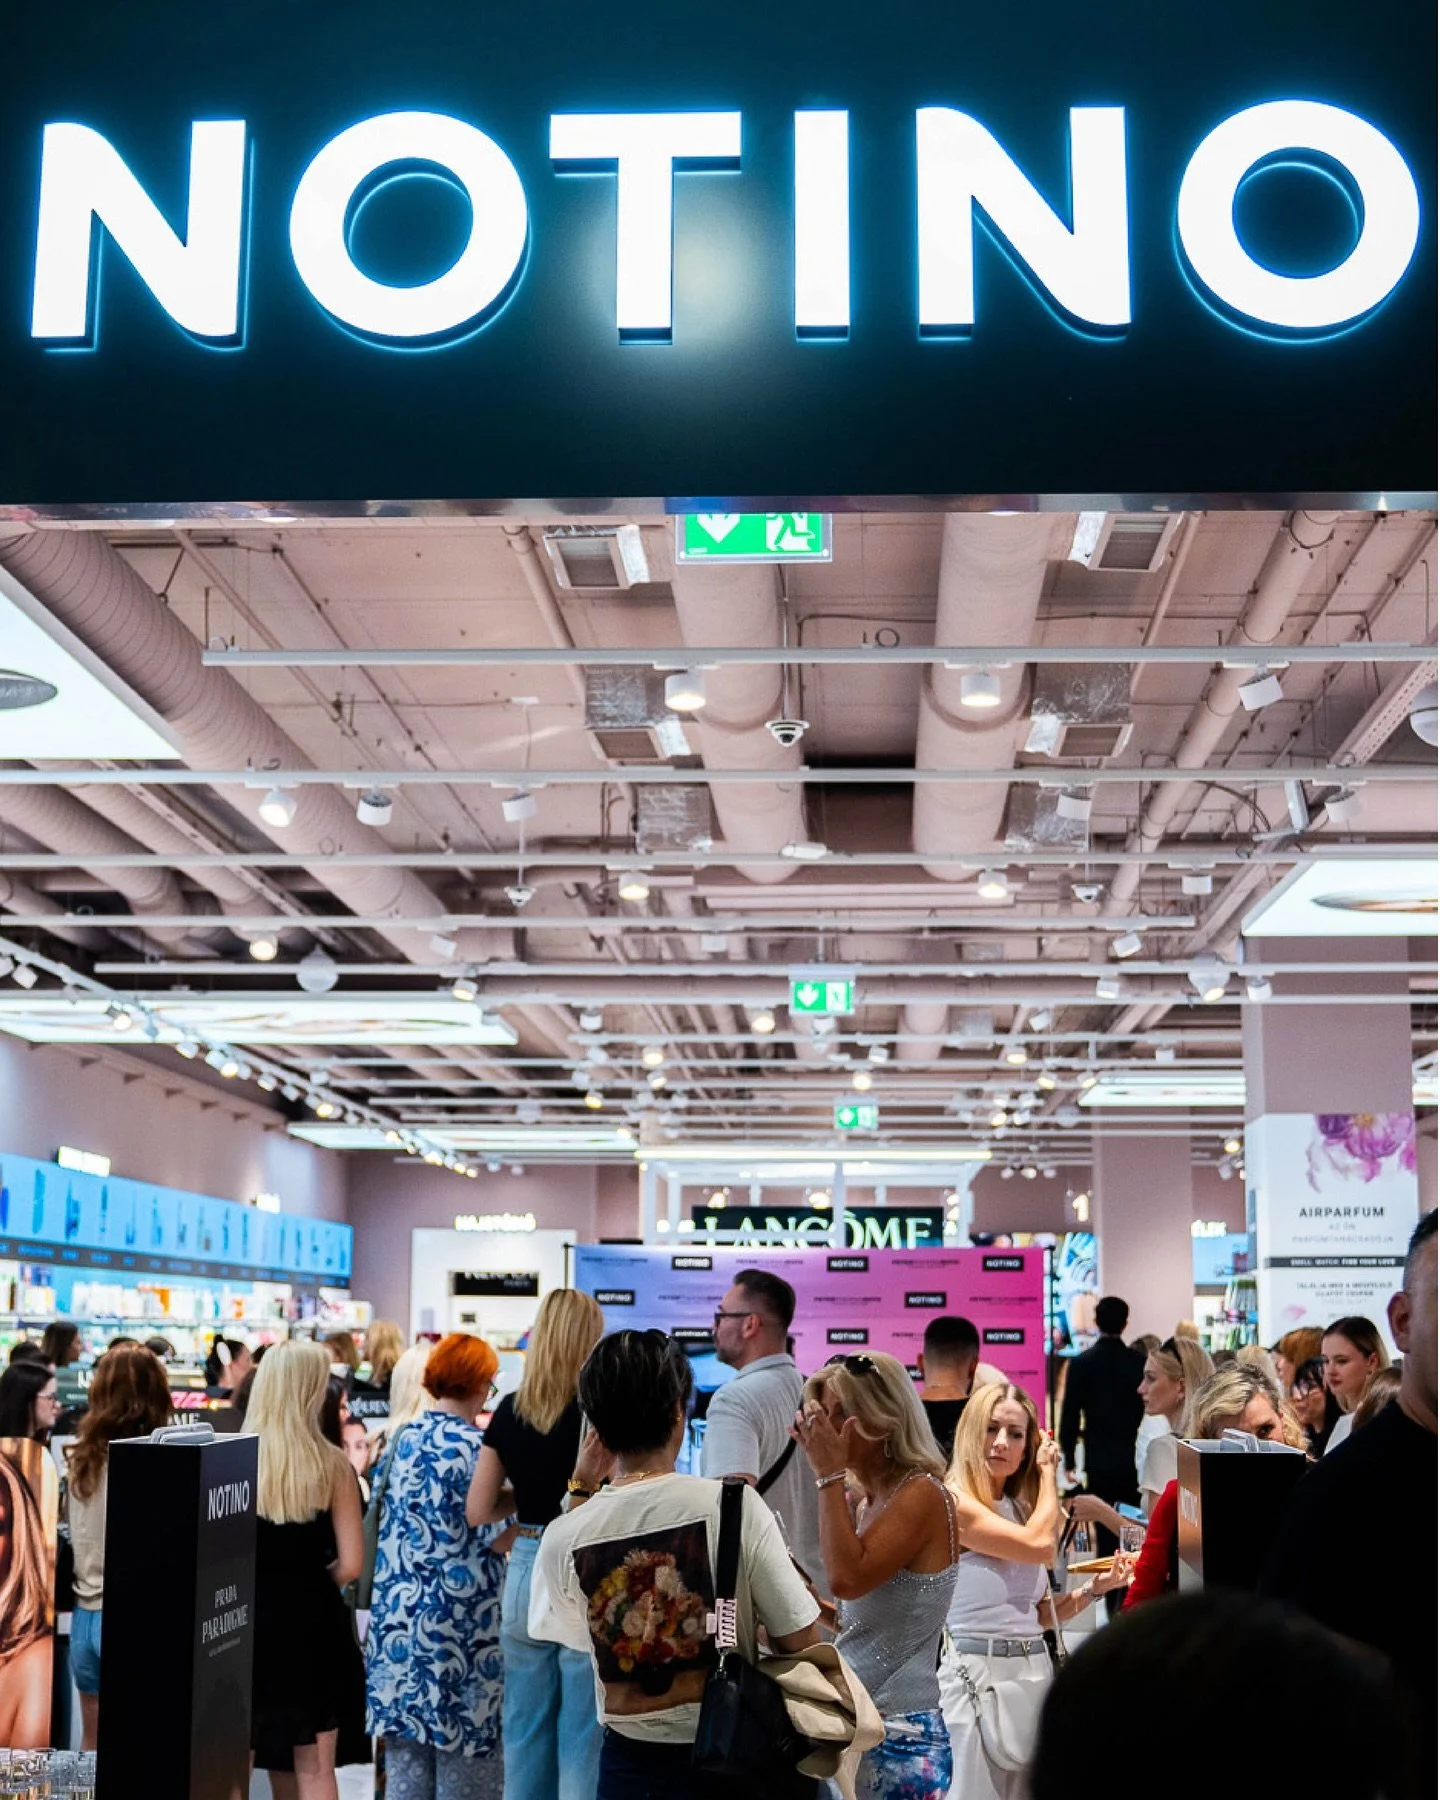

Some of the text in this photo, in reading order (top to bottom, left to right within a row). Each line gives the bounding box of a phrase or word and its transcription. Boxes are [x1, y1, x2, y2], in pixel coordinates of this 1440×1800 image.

[29, 98, 1422, 344] NOTINO
[1299, 1206, 1385, 1218] AIRPARFUM
[829, 1259, 865, 1269] NOTINO
[986, 1259, 1021, 1269] NOTINO
[596, 1293, 632, 1302] NOTINO
[908, 1295, 943, 1305] NOTINO
[830, 1331, 865, 1341] NOTINO
[986, 1331, 1022, 1341] NOTINO
[208, 1481, 250, 1521] NOTINO
[215, 1584, 238, 1609] PRADA
